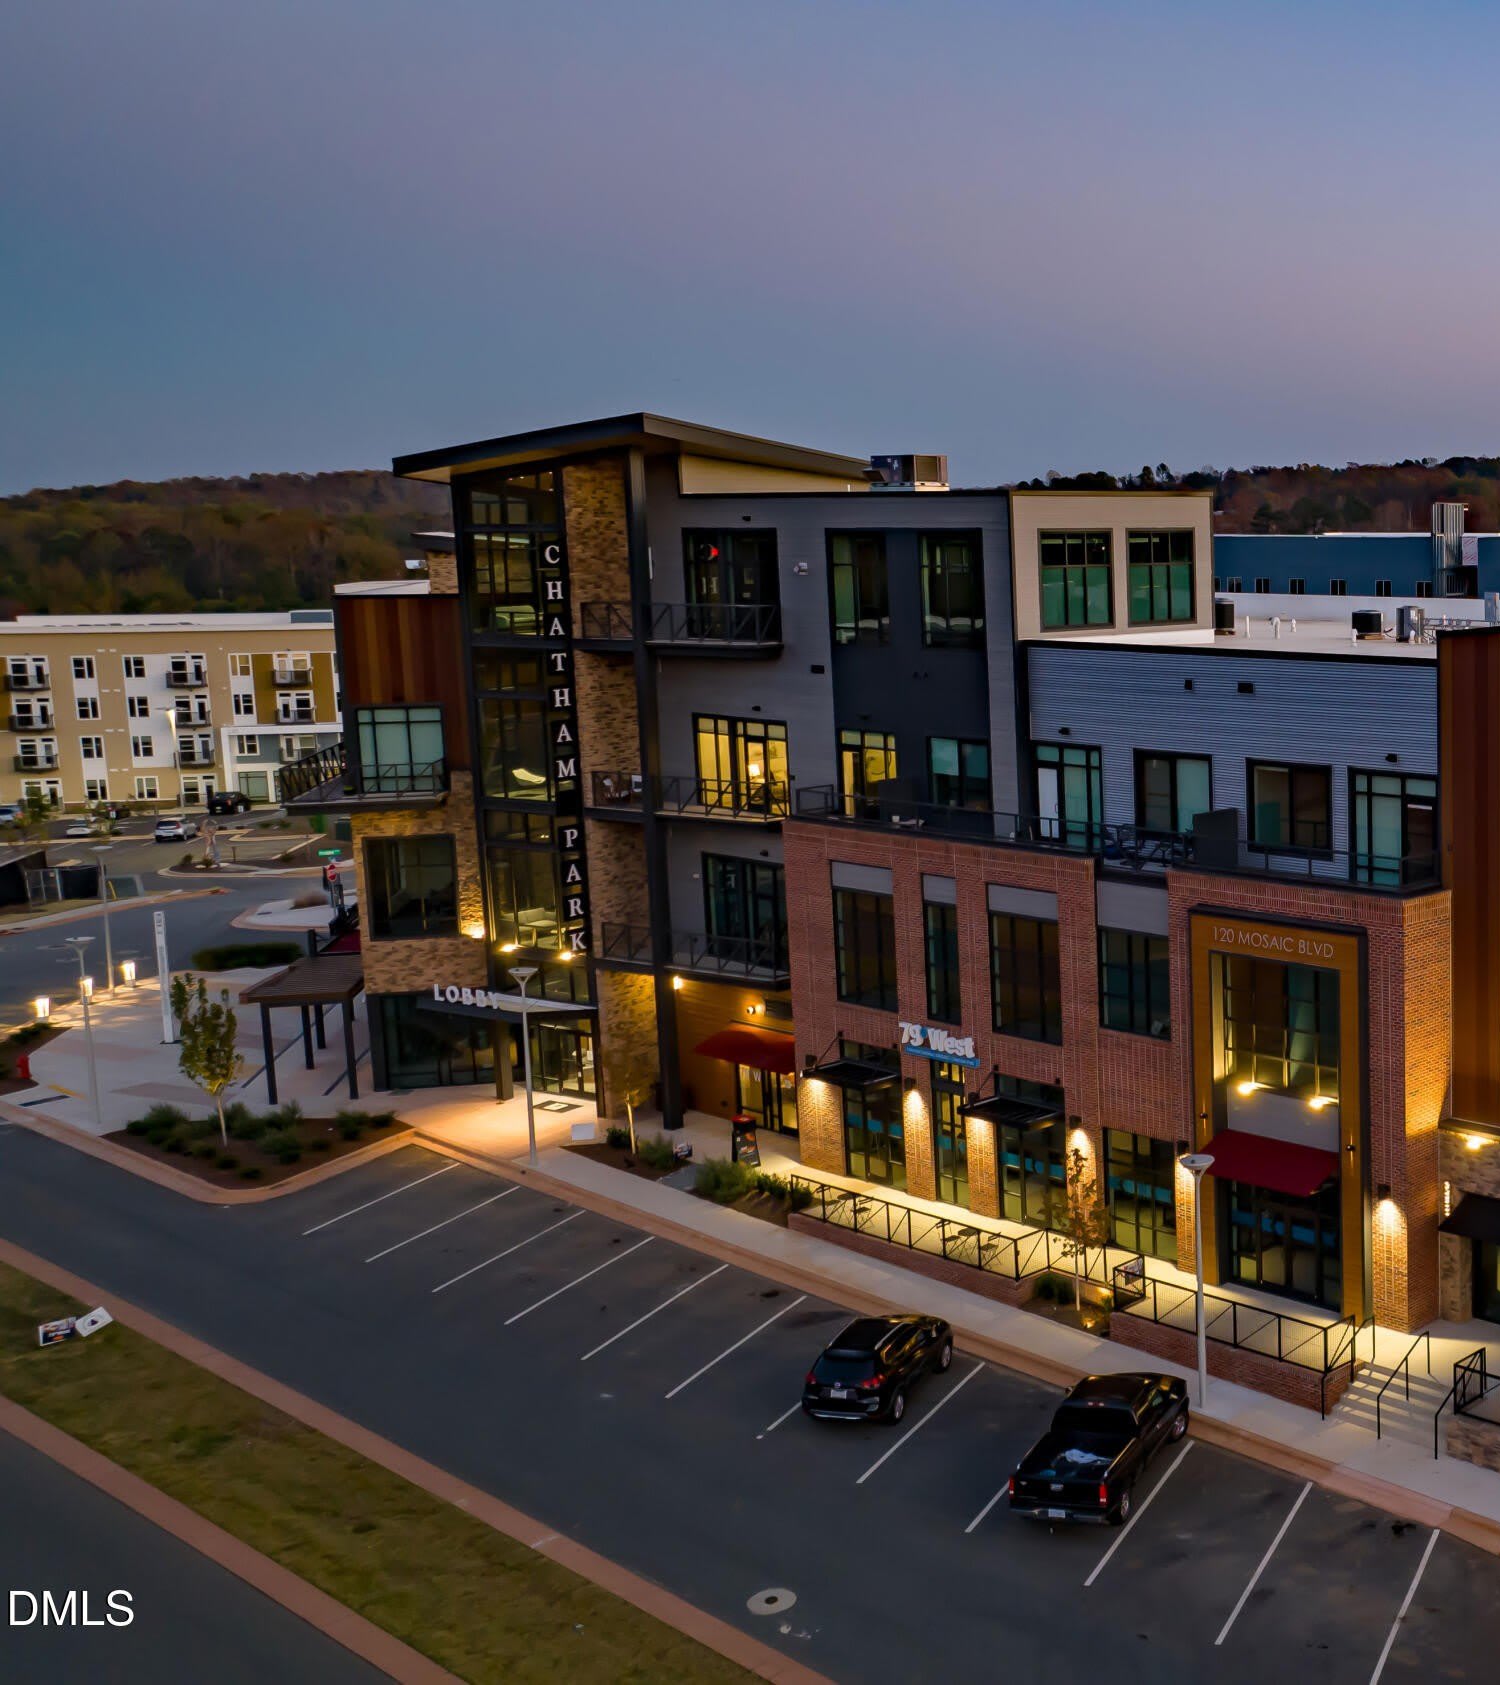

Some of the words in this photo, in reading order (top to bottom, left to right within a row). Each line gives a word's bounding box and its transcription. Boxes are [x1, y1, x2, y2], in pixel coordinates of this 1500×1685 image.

[544, 545, 577, 778] CHATHAM
[564, 829, 587, 951] PARK
[1213, 926, 1235, 943] 120
[1238, 930, 1294, 953] MOSAIC
[1298, 939, 1334, 958] BLVD
[433, 983, 500, 1010] LOBBY
[898, 1021, 924, 1047] 79
[927, 1027, 976, 1059] West
